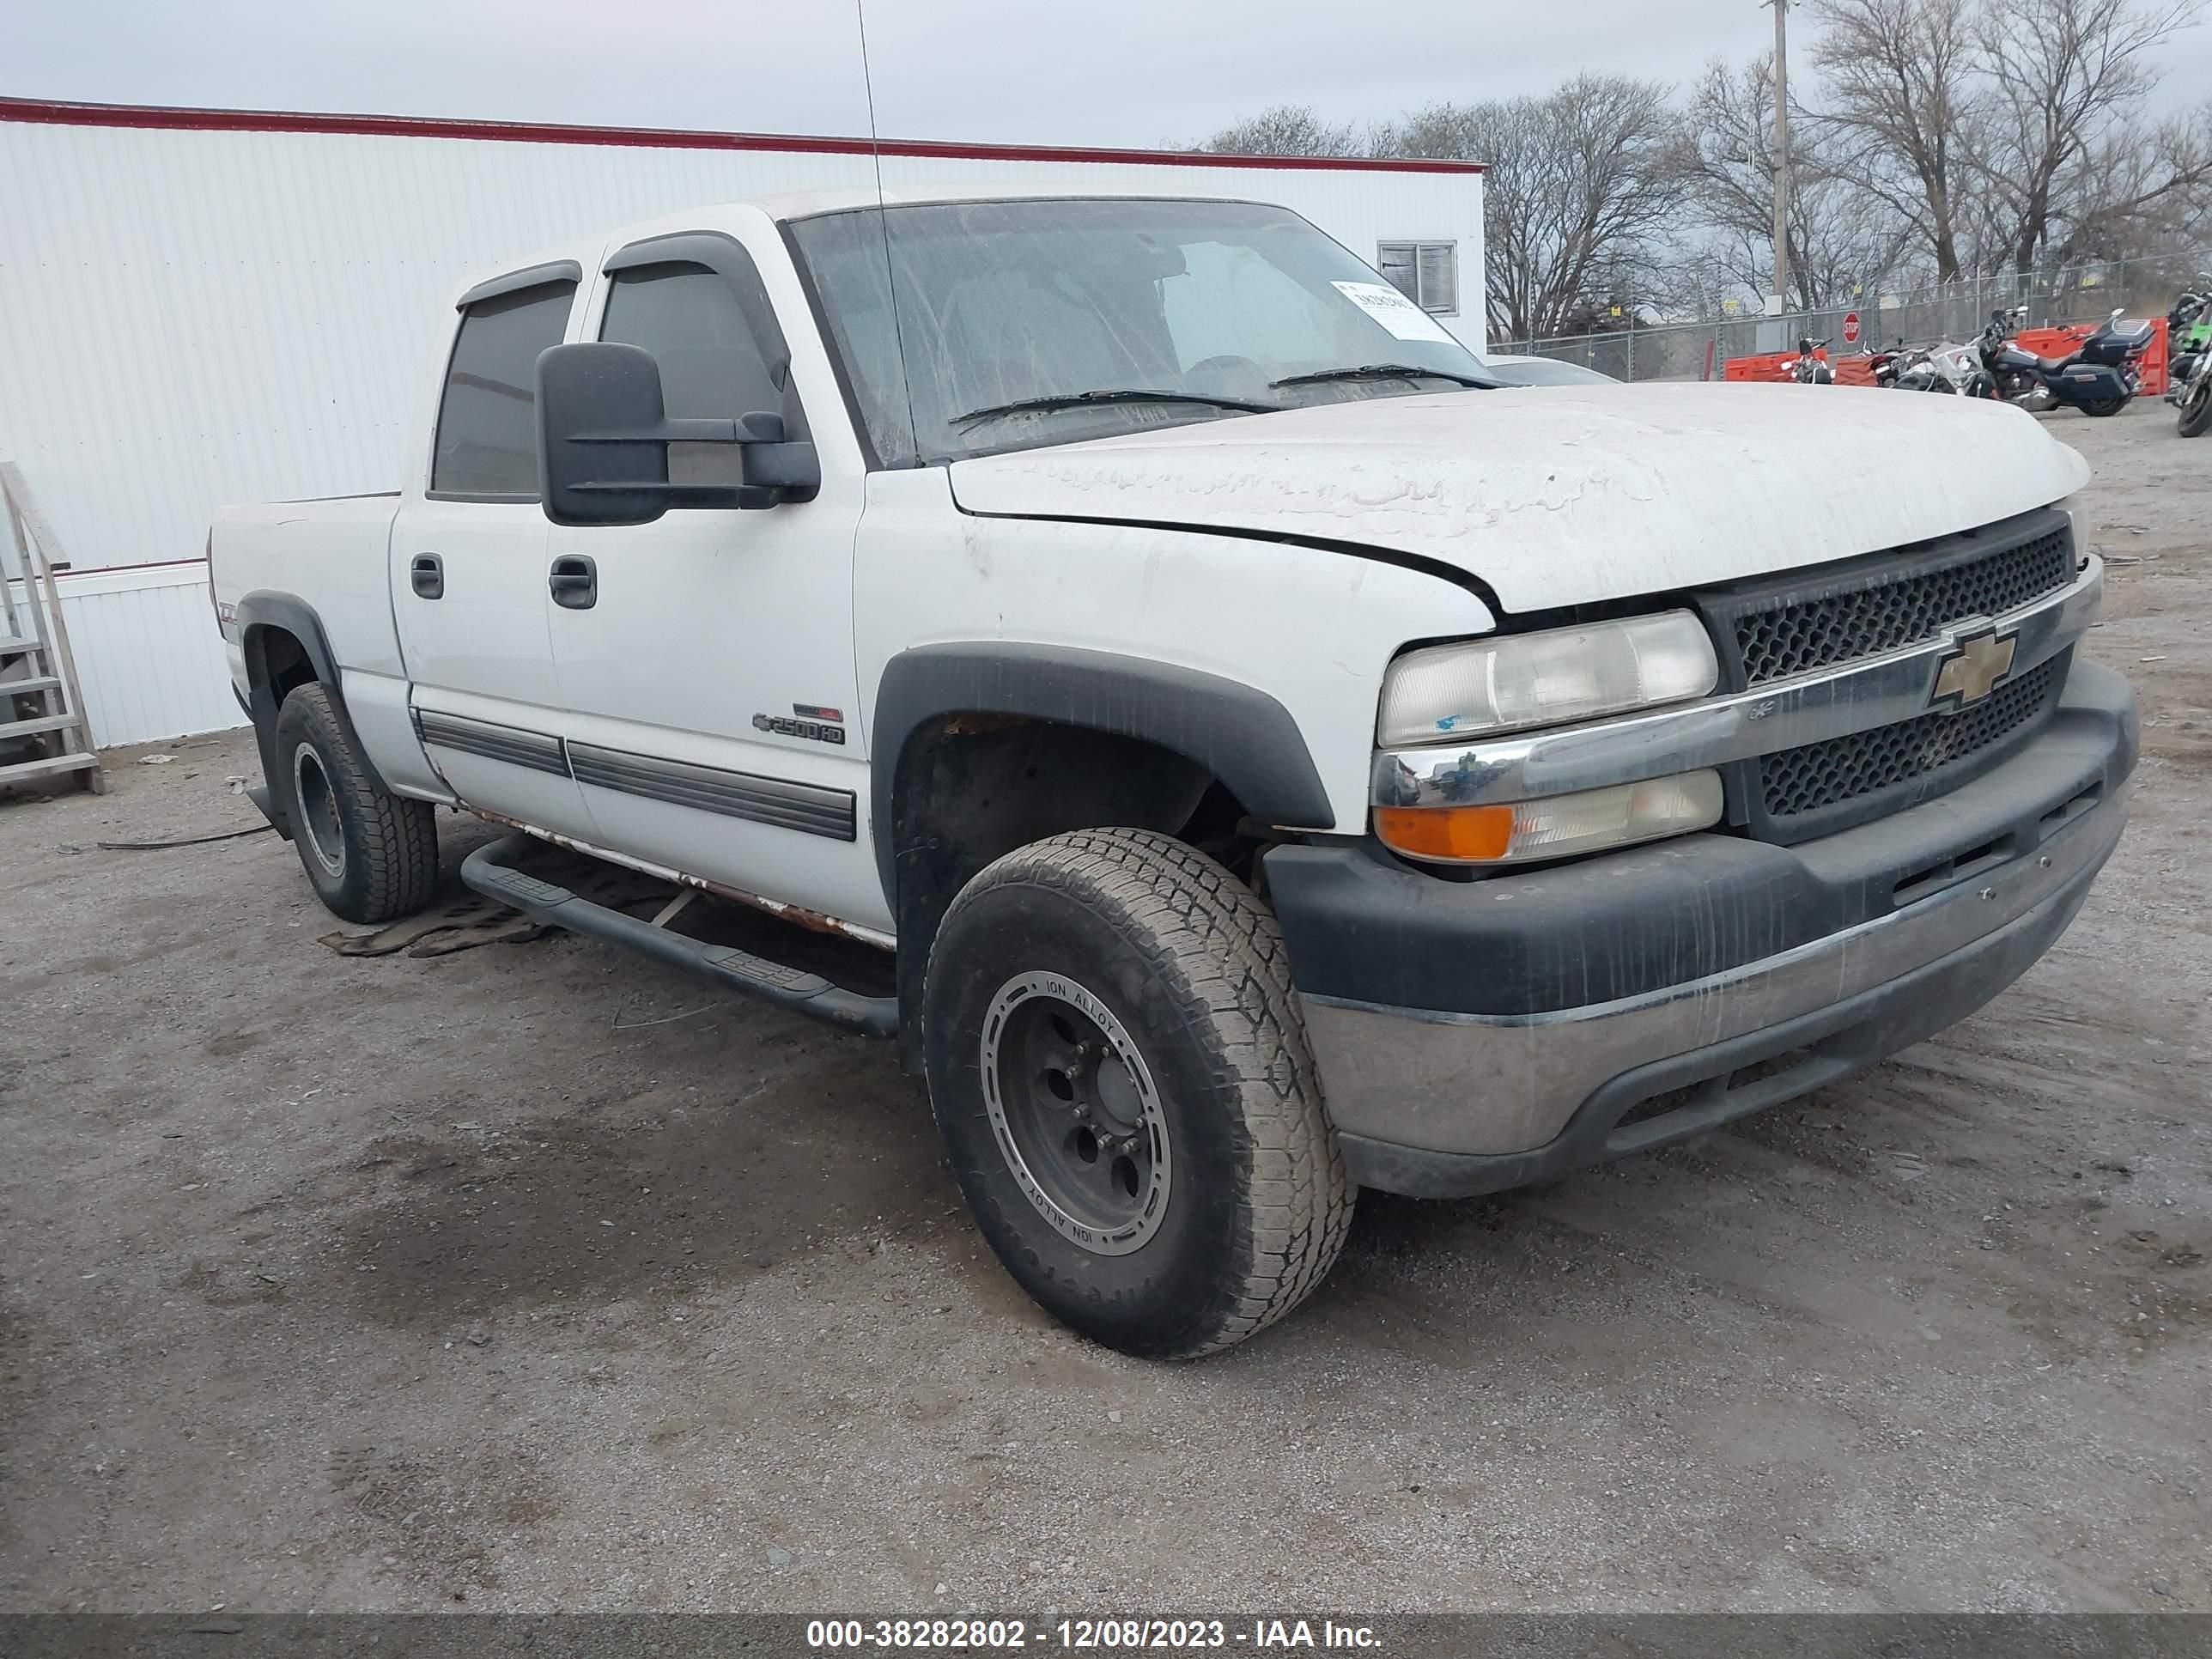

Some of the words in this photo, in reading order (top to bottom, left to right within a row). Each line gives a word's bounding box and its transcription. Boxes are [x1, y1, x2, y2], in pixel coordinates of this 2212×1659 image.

[1844, 321, 1859, 333] STOP
[1046, 981, 1066, 997] ION
[1073, 994, 1115, 1033] ALLOY
[1030, 1188, 1066, 1227] ALLOY
[1073, 1227, 1093, 1243] ION
